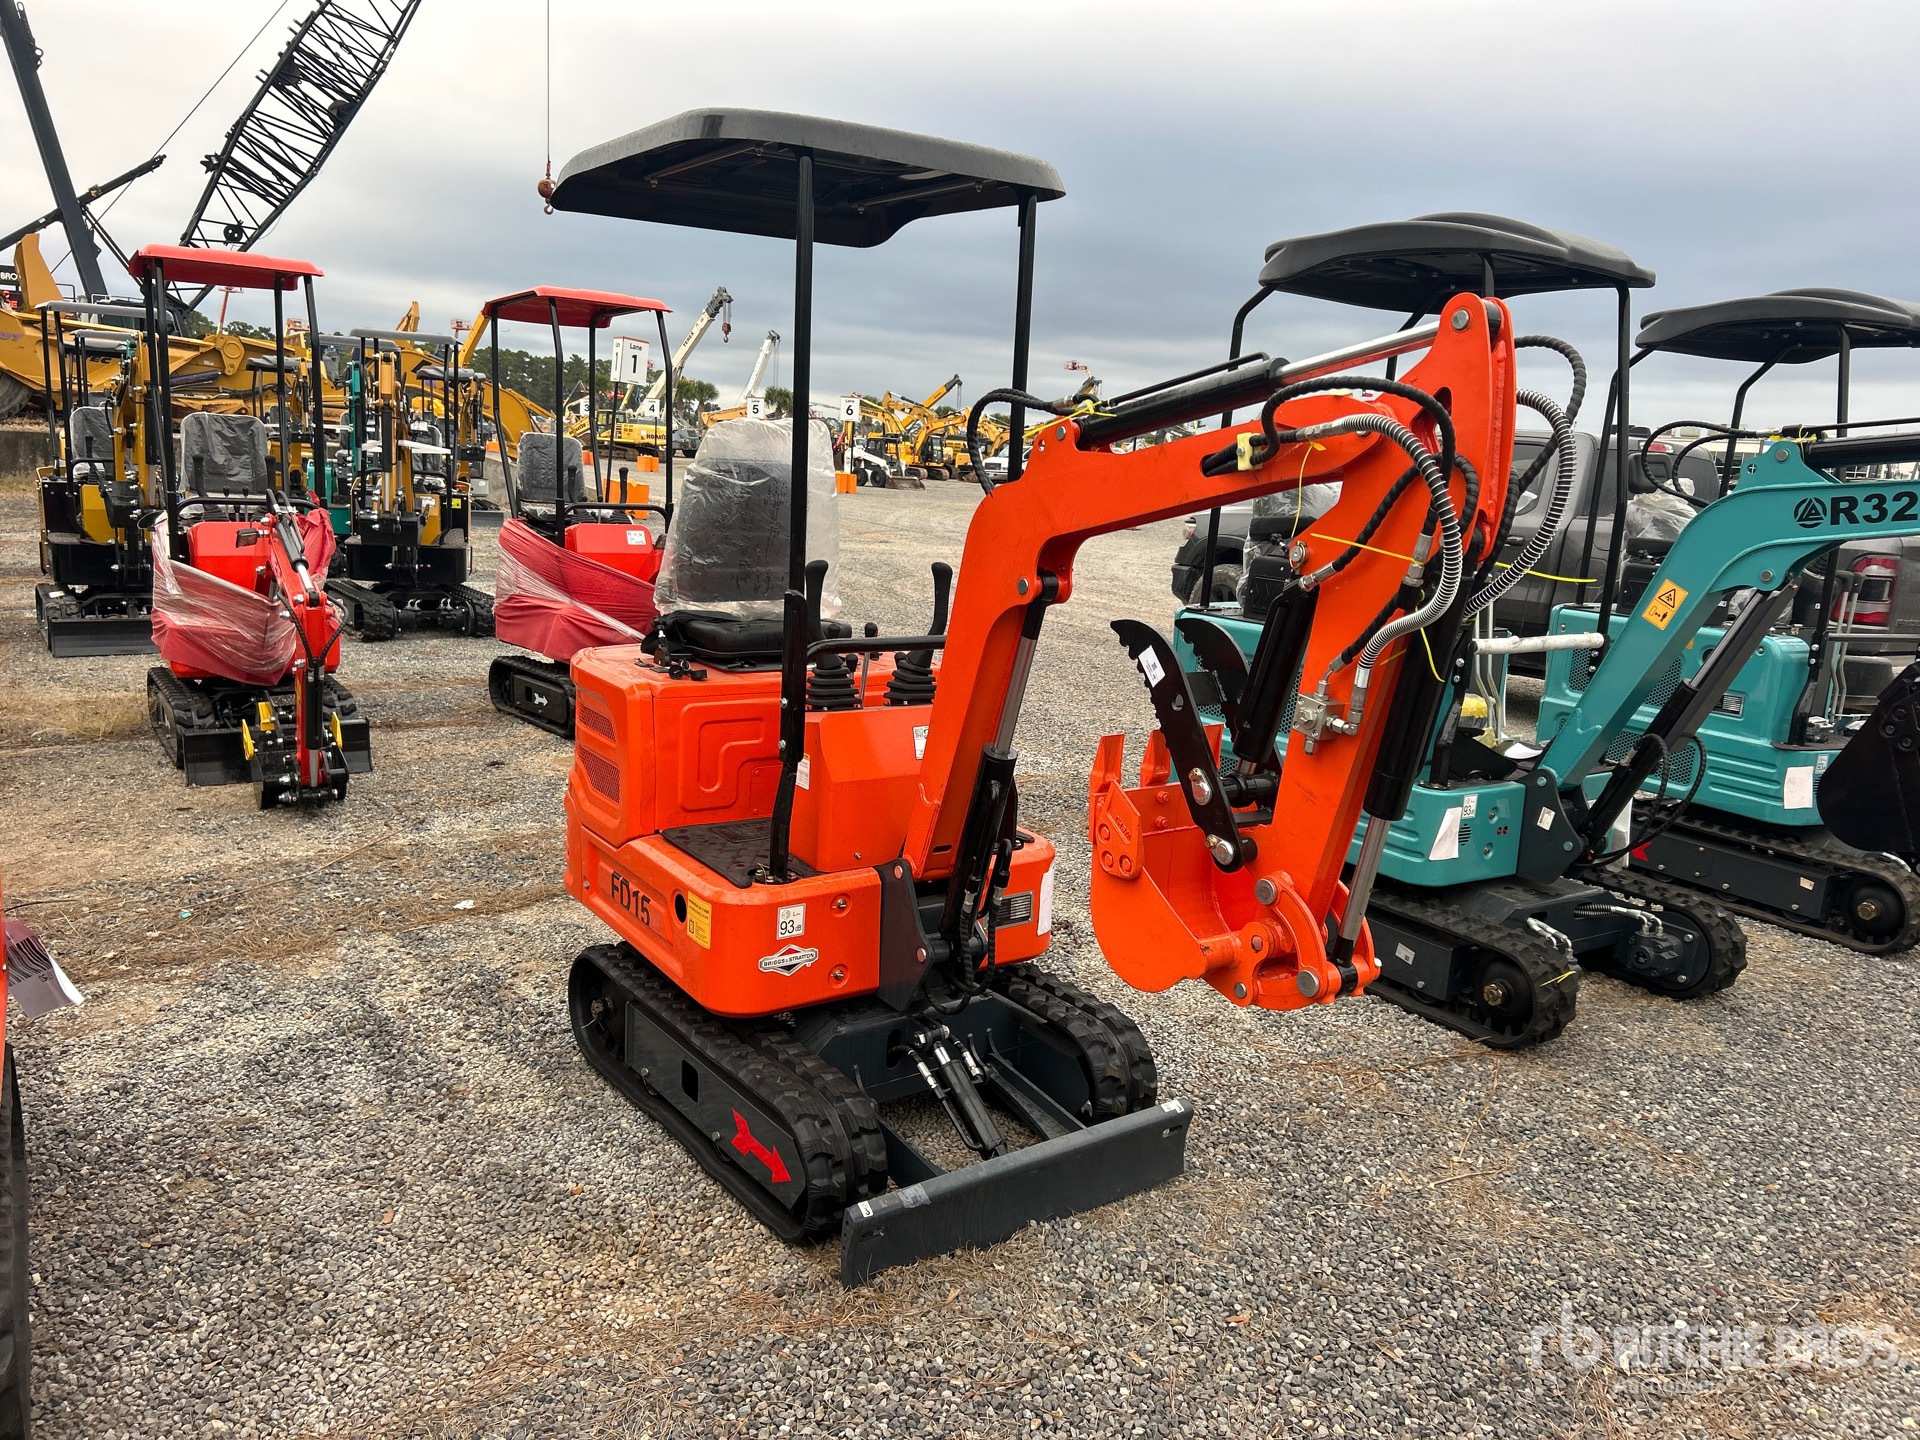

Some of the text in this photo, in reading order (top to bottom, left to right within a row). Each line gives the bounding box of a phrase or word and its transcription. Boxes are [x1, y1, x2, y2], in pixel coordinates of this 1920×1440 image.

[682, 331, 694, 347] TEREX
[629, 343, 642, 351] Lane
[632, 354, 637, 374] 1
[584, 404, 590, 412] 3
[649, 404, 655, 412] 4
[752, 404, 759, 414] 5
[845, 404, 854, 416] 6
[611, 870, 651, 927] FD15
[780, 919, 802, 936] 93 dB
